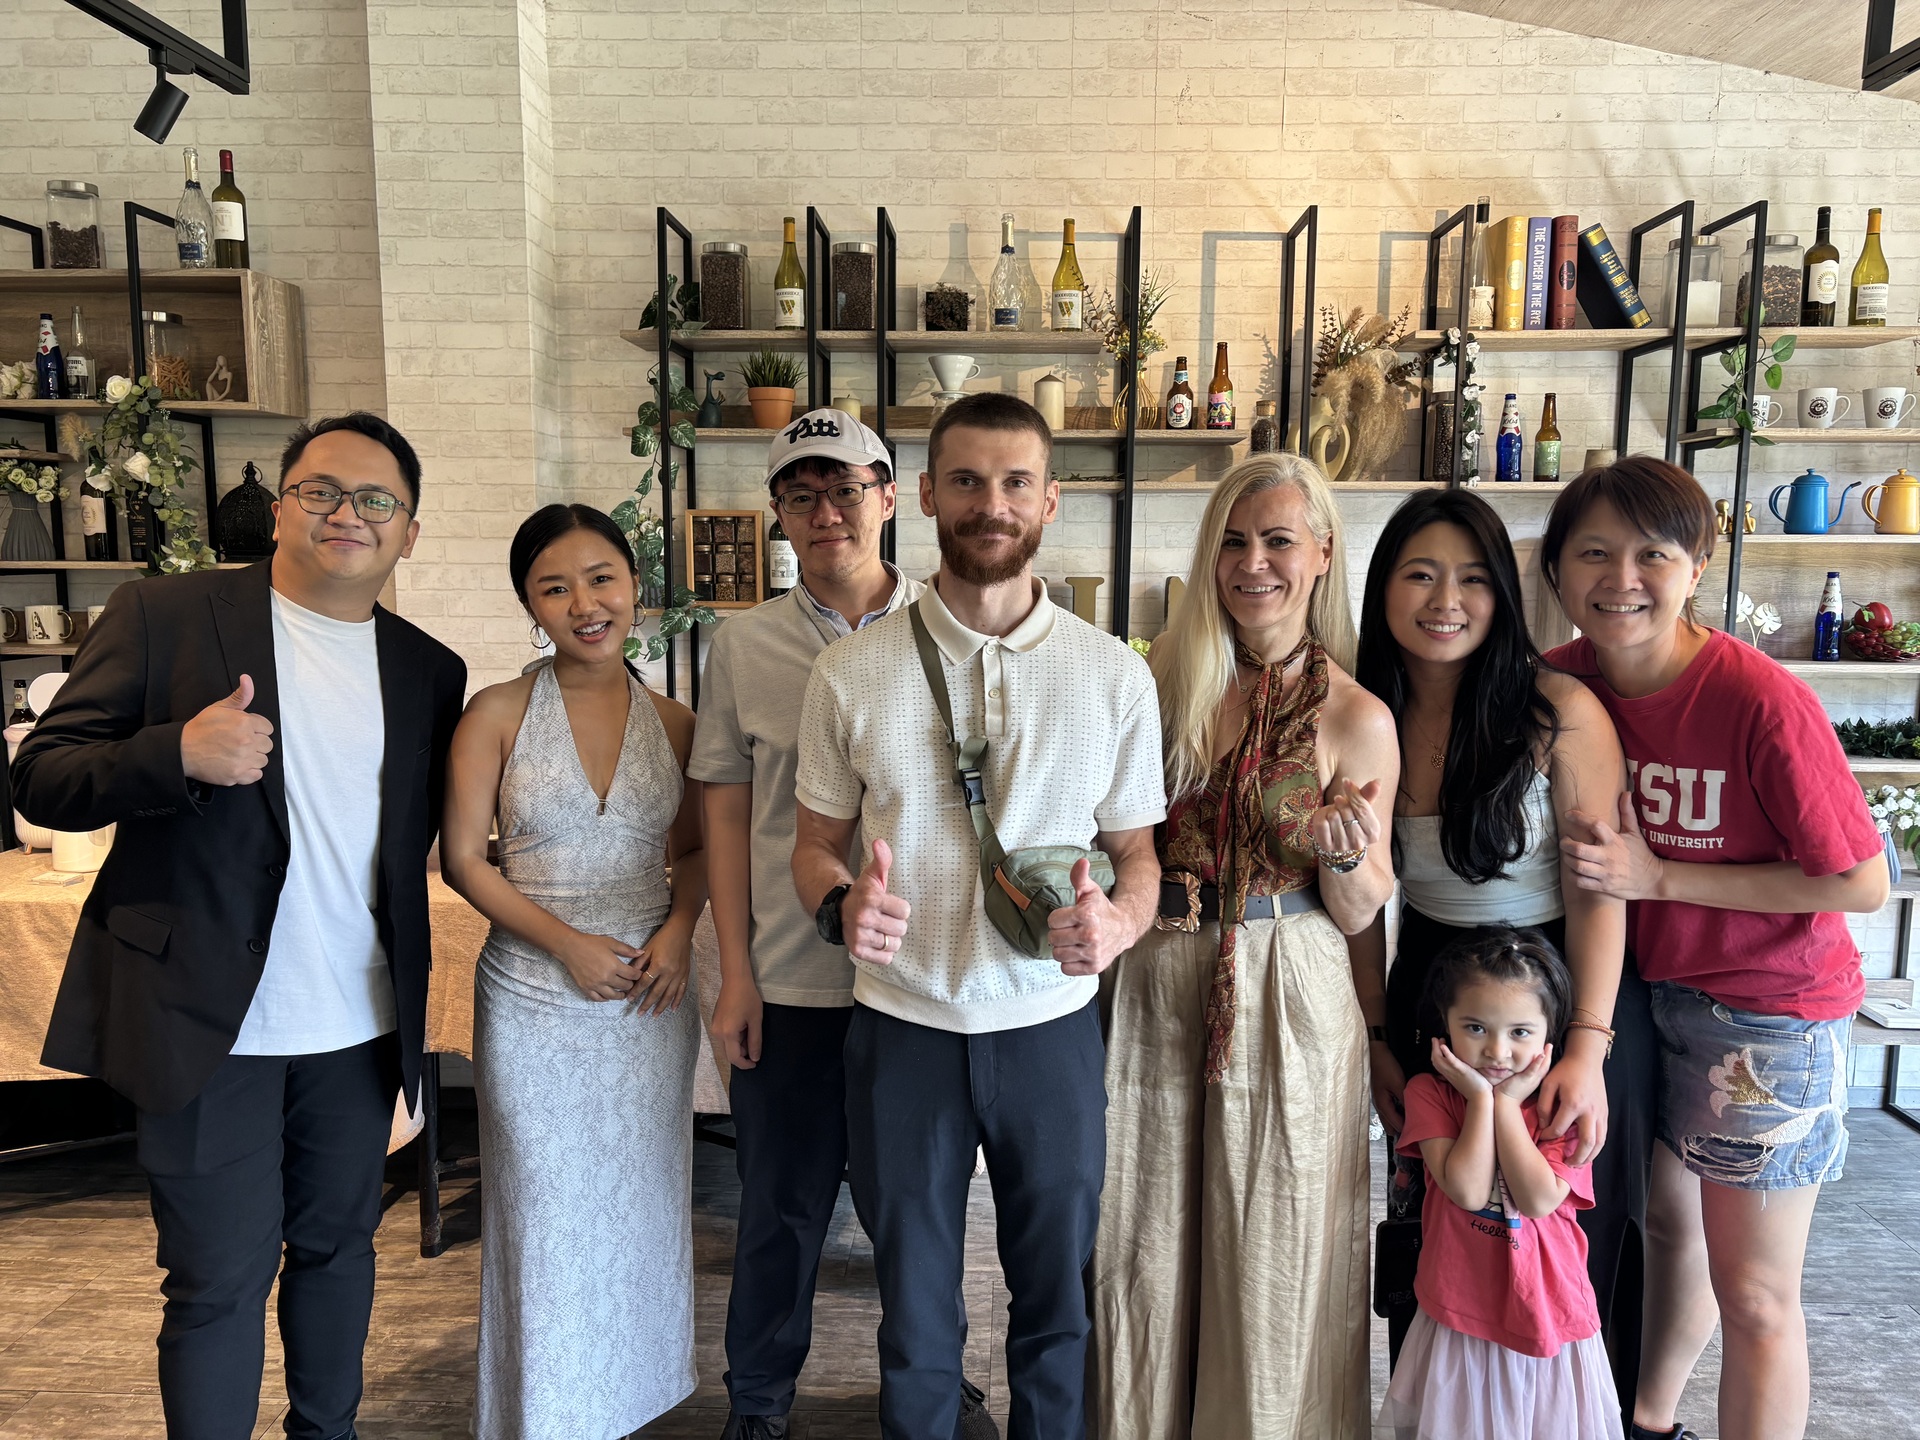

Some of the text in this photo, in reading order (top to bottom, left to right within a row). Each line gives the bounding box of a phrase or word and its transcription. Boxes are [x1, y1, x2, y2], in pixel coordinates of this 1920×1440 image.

[1530, 226, 1546, 325] THE CATCHER IN THE RYE
[784, 418, 840, 444] Pitt
[1650, 831, 1724, 849] UNIVERSITY
[1471, 1220, 1507, 1239] Hello
